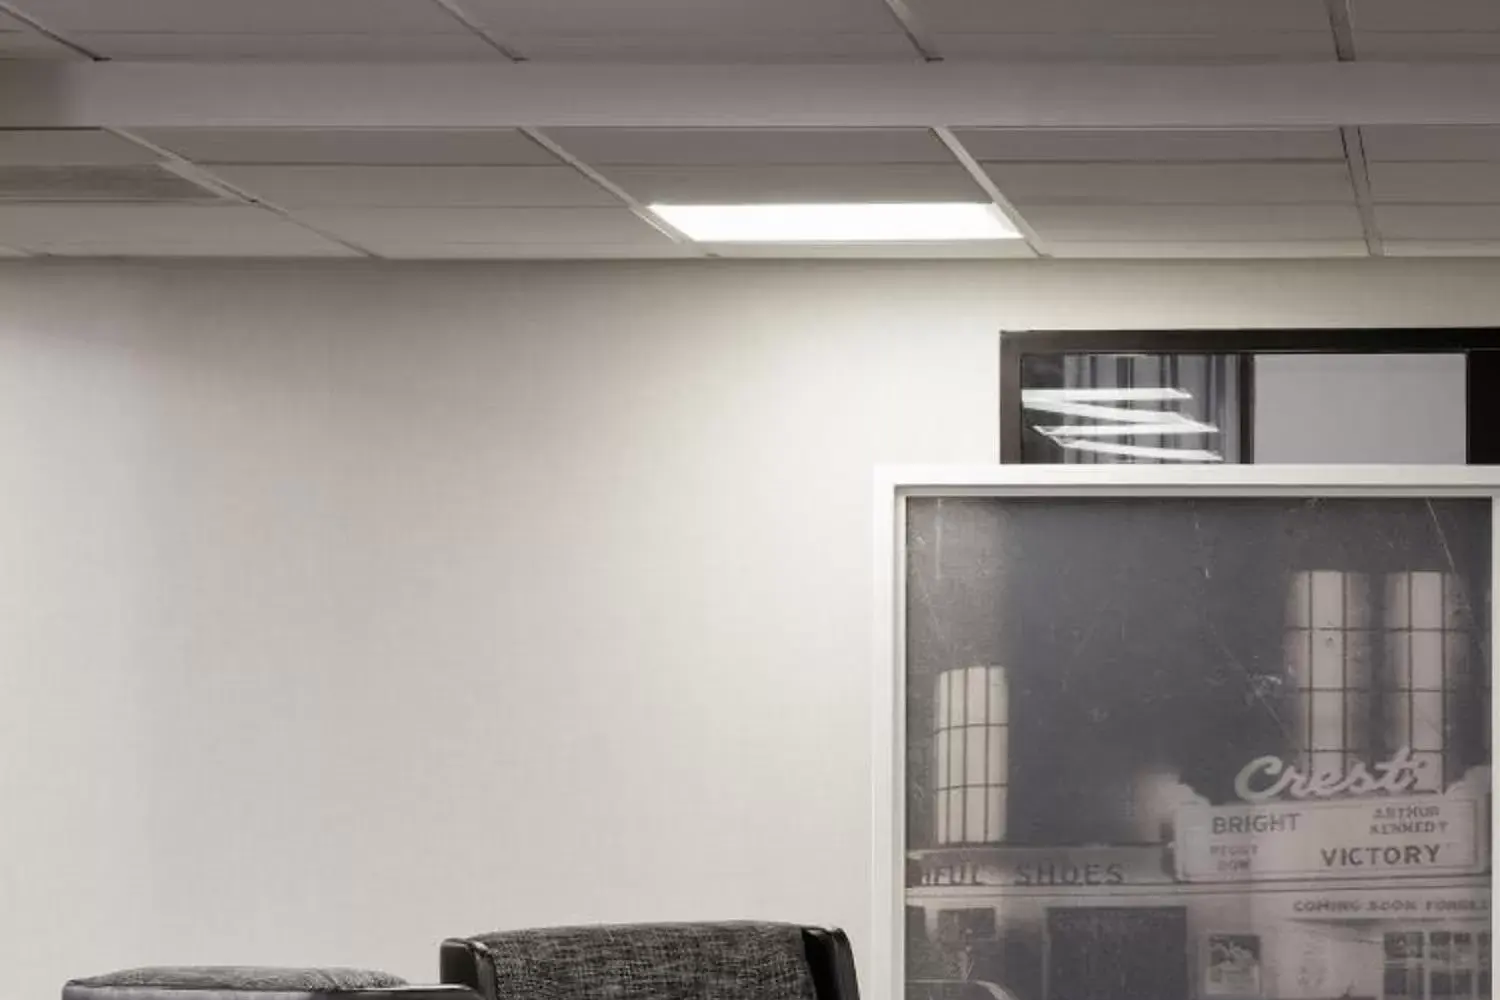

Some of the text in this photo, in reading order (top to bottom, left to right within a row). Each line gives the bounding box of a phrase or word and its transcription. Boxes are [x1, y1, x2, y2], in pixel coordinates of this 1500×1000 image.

[1234, 747, 1420, 800] Crest
[1211, 813, 1301, 836] BRIGHT
[1320, 844, 1441, 867] VICTORY
[1013, 863, 1124, 886] SHOES
[1293, 900, 1361, 912] COMING
